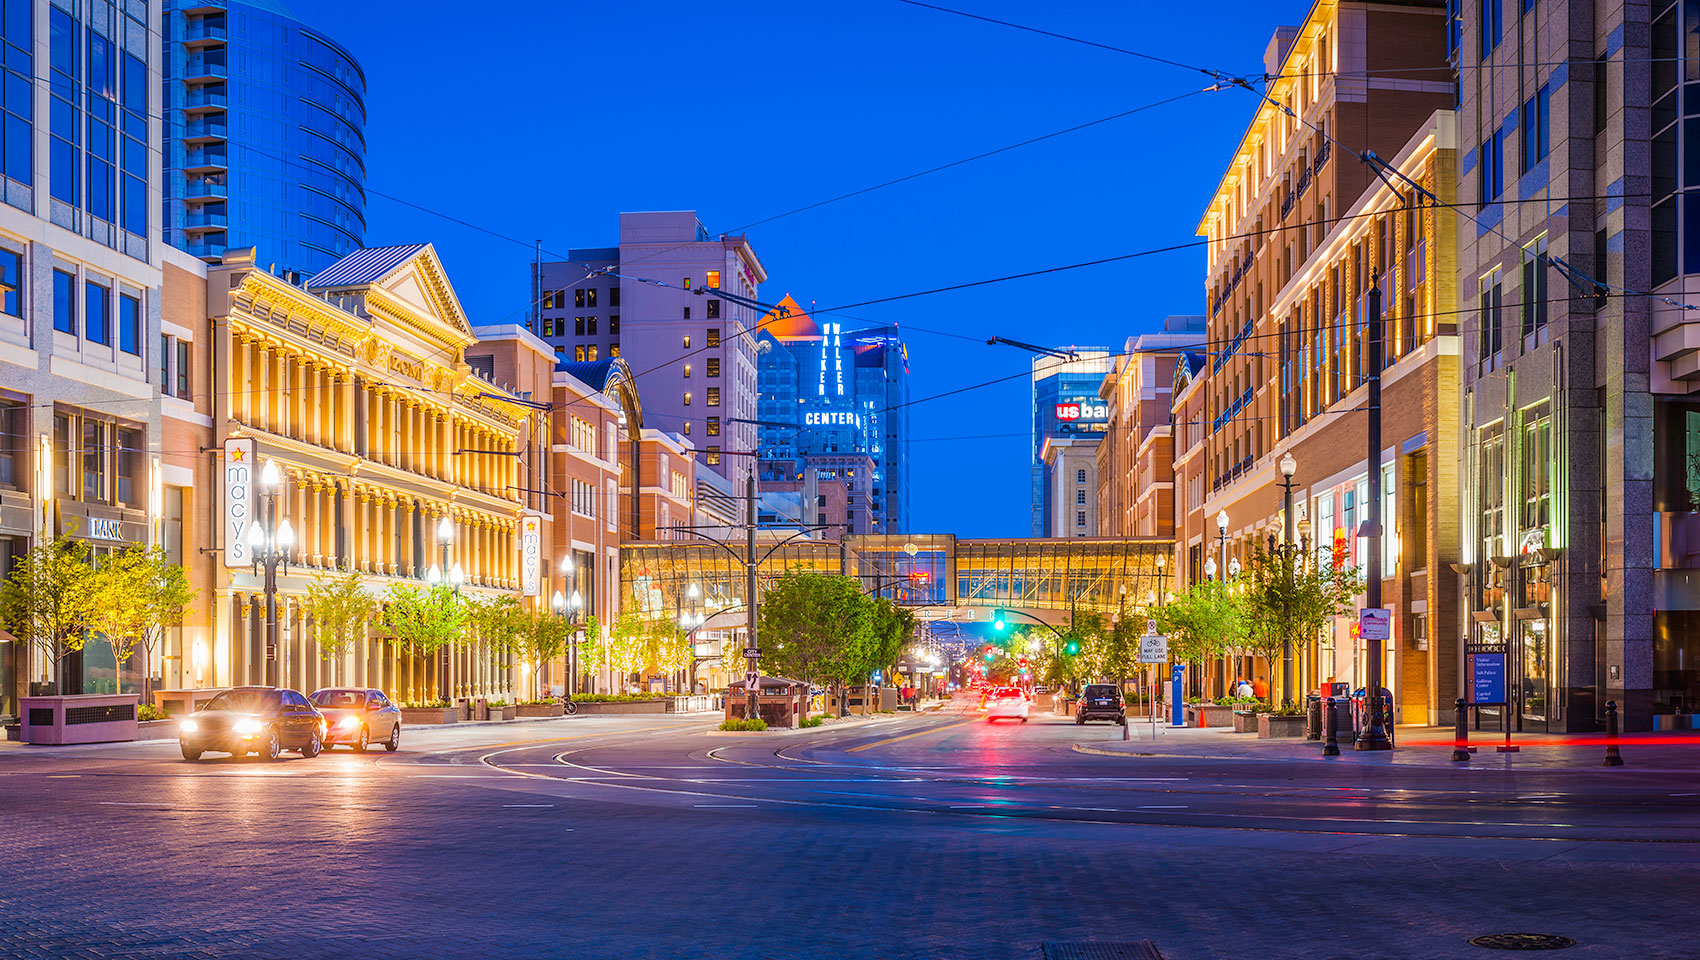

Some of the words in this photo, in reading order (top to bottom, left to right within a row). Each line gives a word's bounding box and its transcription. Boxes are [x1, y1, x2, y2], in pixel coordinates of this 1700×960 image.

[819, 323, 831, 396] WALKER
[832, 322, 844, 396] WALKER
[805, 412, 854, 425] CENTER
[1081, 403, 1108, 418] ba
[94, 520, 124, 540] BANK
